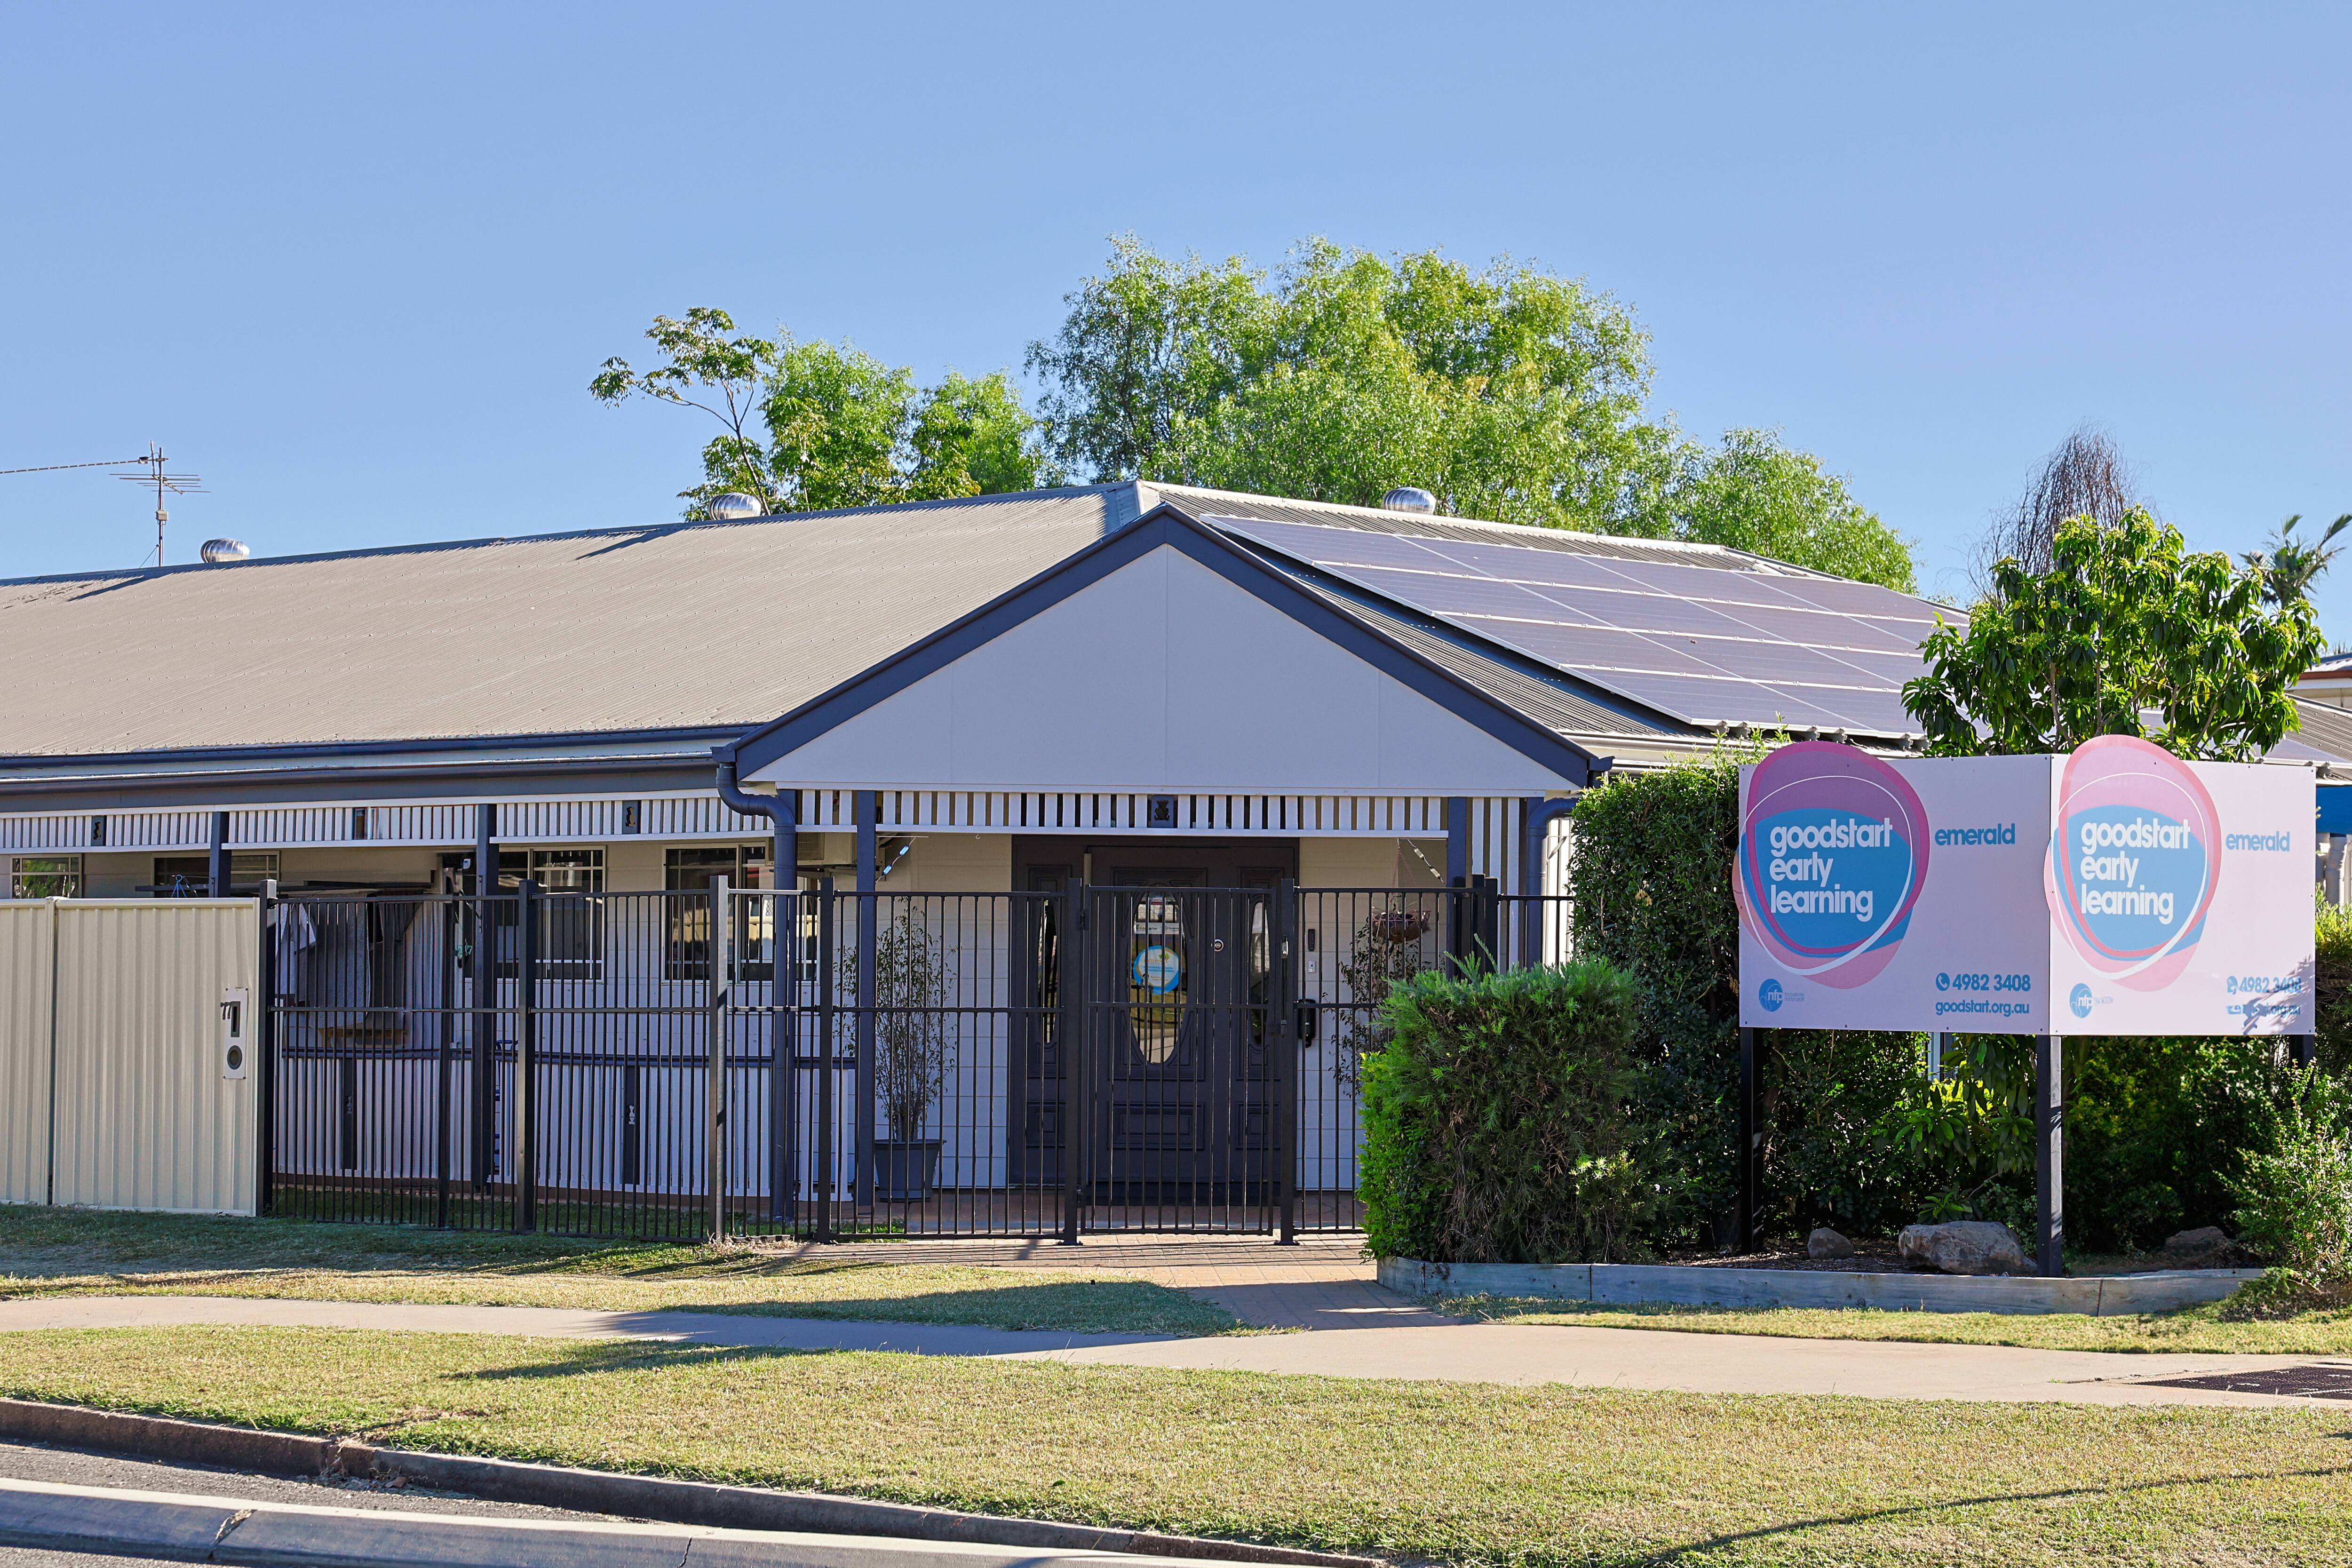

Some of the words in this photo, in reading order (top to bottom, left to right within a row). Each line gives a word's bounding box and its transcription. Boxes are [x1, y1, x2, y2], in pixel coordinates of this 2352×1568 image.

[1770, 818, 1893, 857] goodstart
[1935, 823, 2015, 845] emerald
[2081, 818, 2191, 855] goodstart
[2225, 831, 2290, 852] emerald
[1770, 852, 1834, 887] early
[2080, 851, 2139, 888] early
[1771, 884, 1873, 922] learning
[2082, 883, 2173, 924] learning
[1953, 974, 1989, 991] 4982
[1994, 974, 2031, 991] 3408
[2240, 977, 2270, 993] 4982
[2273, 976, 2302, 994] 3408
[1768, 989, 1783, 1003] nfp
[2078, 994, 2092, 1009] nfp
[1936, 999, 2029, 1017] goodstart.org.au
